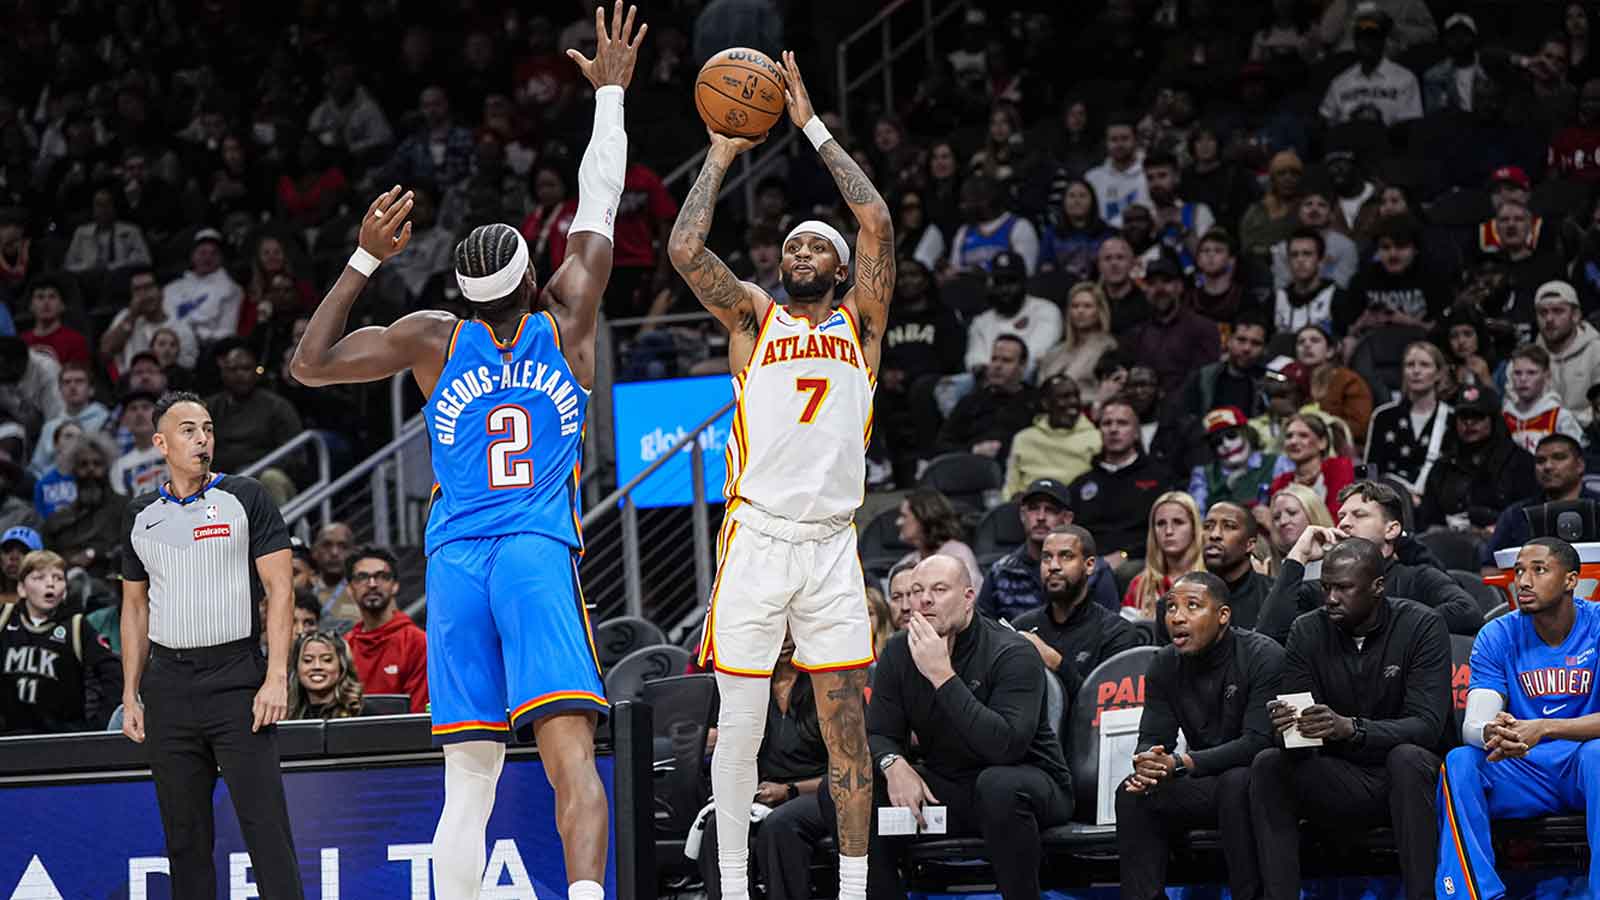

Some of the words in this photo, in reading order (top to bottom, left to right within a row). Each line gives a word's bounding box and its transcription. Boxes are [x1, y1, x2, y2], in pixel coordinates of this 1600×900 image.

[727, 50, 782, 82] Wilson
[760, 333, 860, 369] ATLANTA
[434, 359, 579, 446] GILGEOUS-ALEXANDER
[796, 377, 830, 424] 7
[486, 403, 534, 490] 2
[194, 527, 230, 538] Emirates
[3, 645, 60, 680] MLK
[16, 677, 38, 704] 11
[1519, 667, 1593, 698] HUNDER
